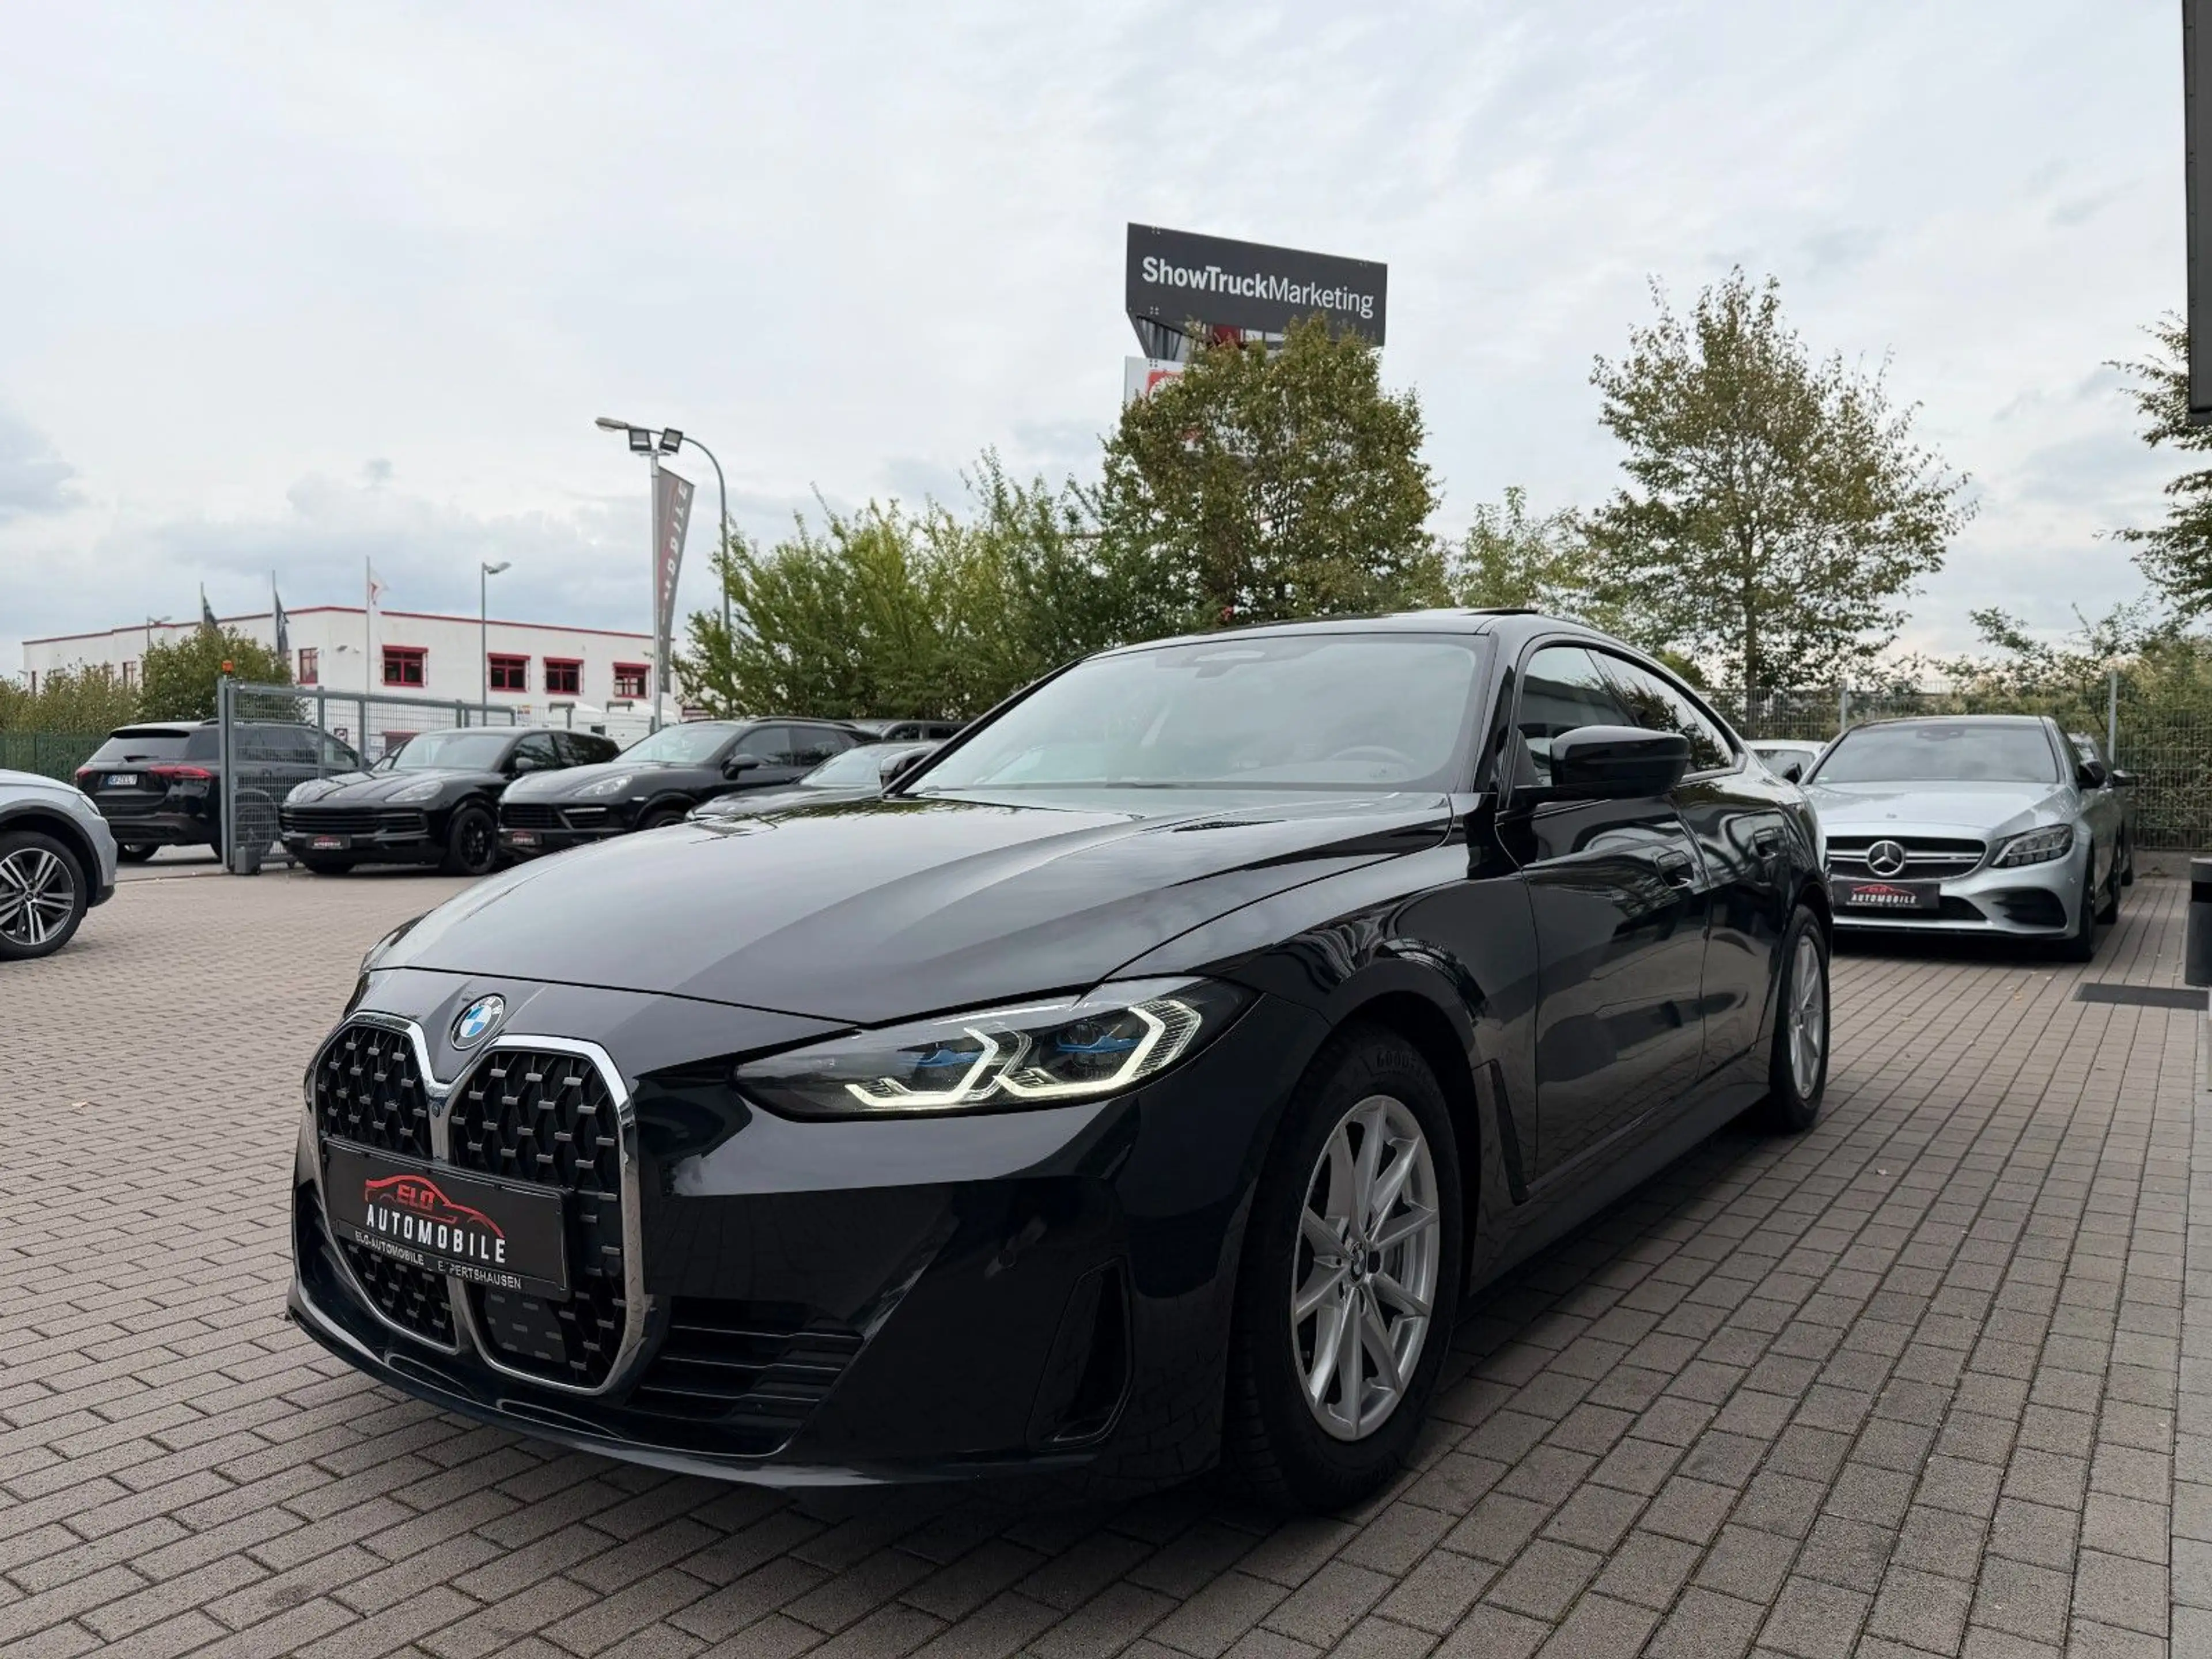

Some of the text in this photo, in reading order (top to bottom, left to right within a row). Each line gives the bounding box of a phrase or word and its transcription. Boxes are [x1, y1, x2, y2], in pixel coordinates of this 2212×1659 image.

[1142, 256, 1374, 319] ShowTruckMarketing
[1851, 893, 1917, 904] AUTOMOBILE
[366, 1203, 506, 1263] AUTOMOBILE
[437, 1260, 522, 1290] EPERTSHAUSEN
